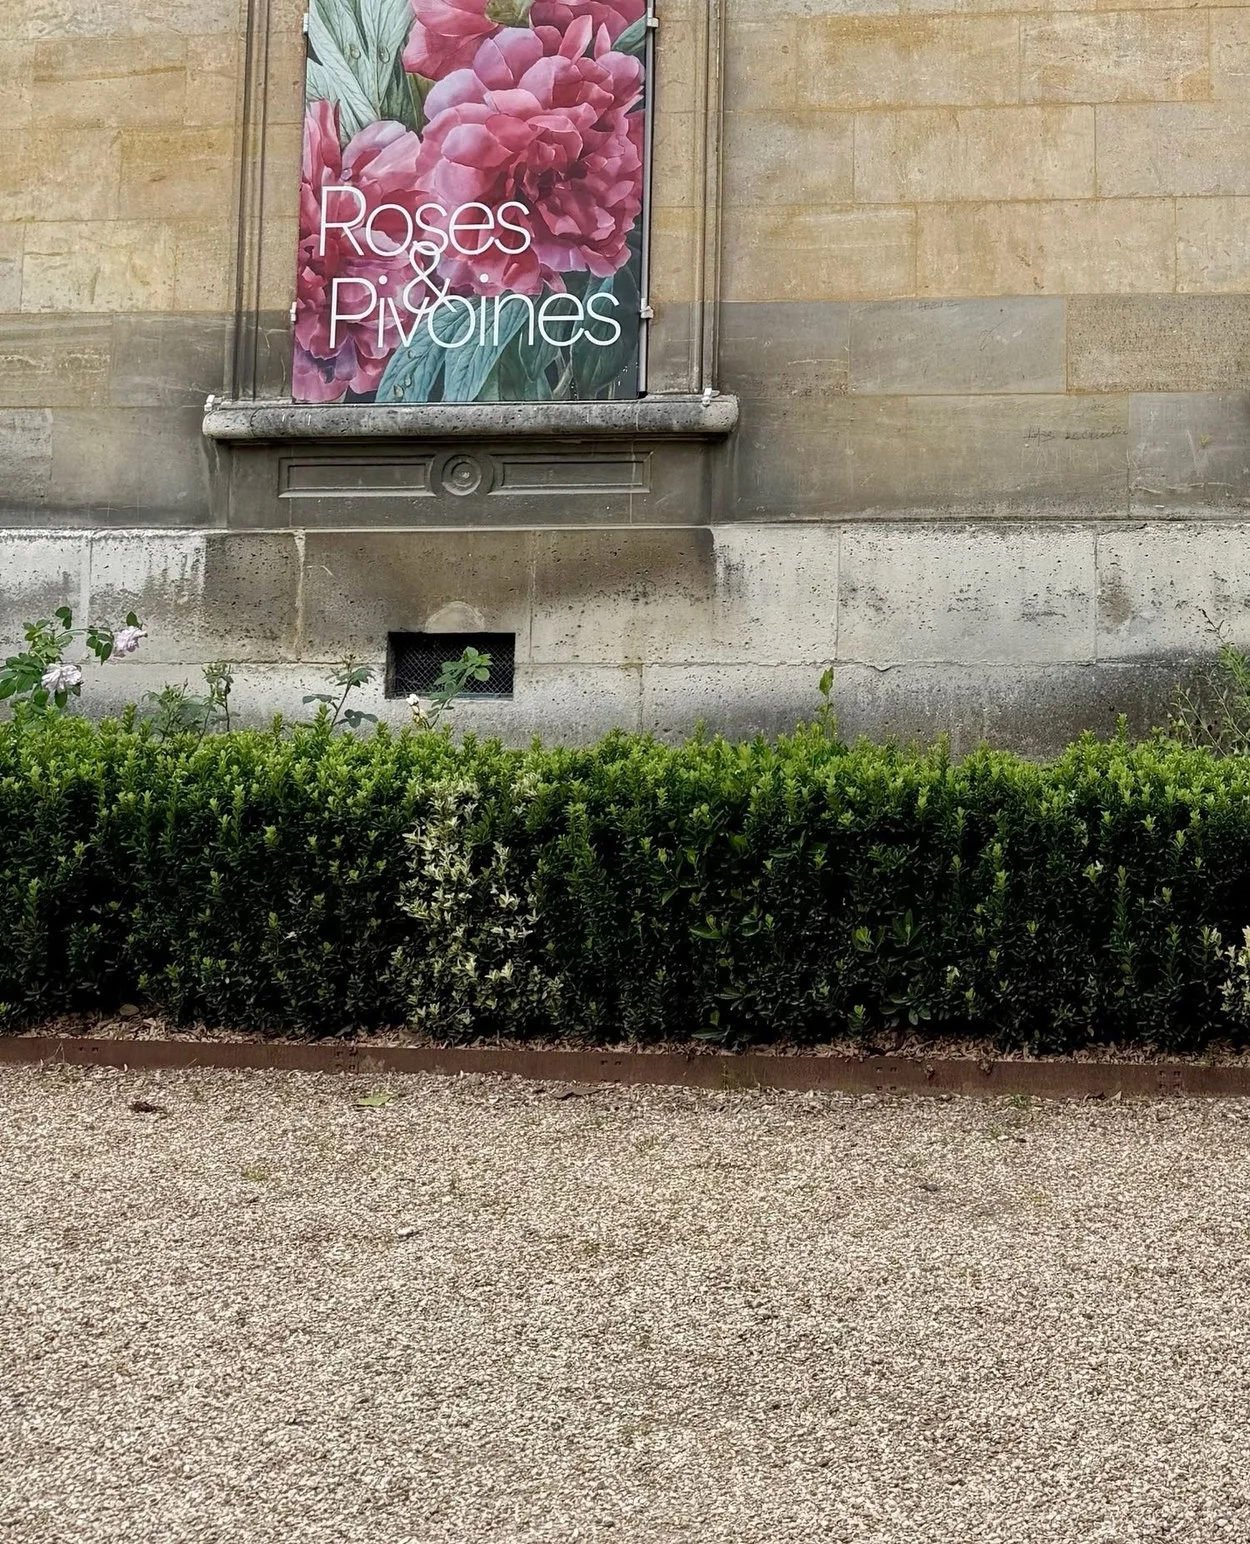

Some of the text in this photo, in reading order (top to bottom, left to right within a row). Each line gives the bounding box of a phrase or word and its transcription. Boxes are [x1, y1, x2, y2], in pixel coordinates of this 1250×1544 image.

[319, 185, 532, 257] Roses
[329, 273, 622, 349] Pivoines
[402, 240, 457, 314] &
